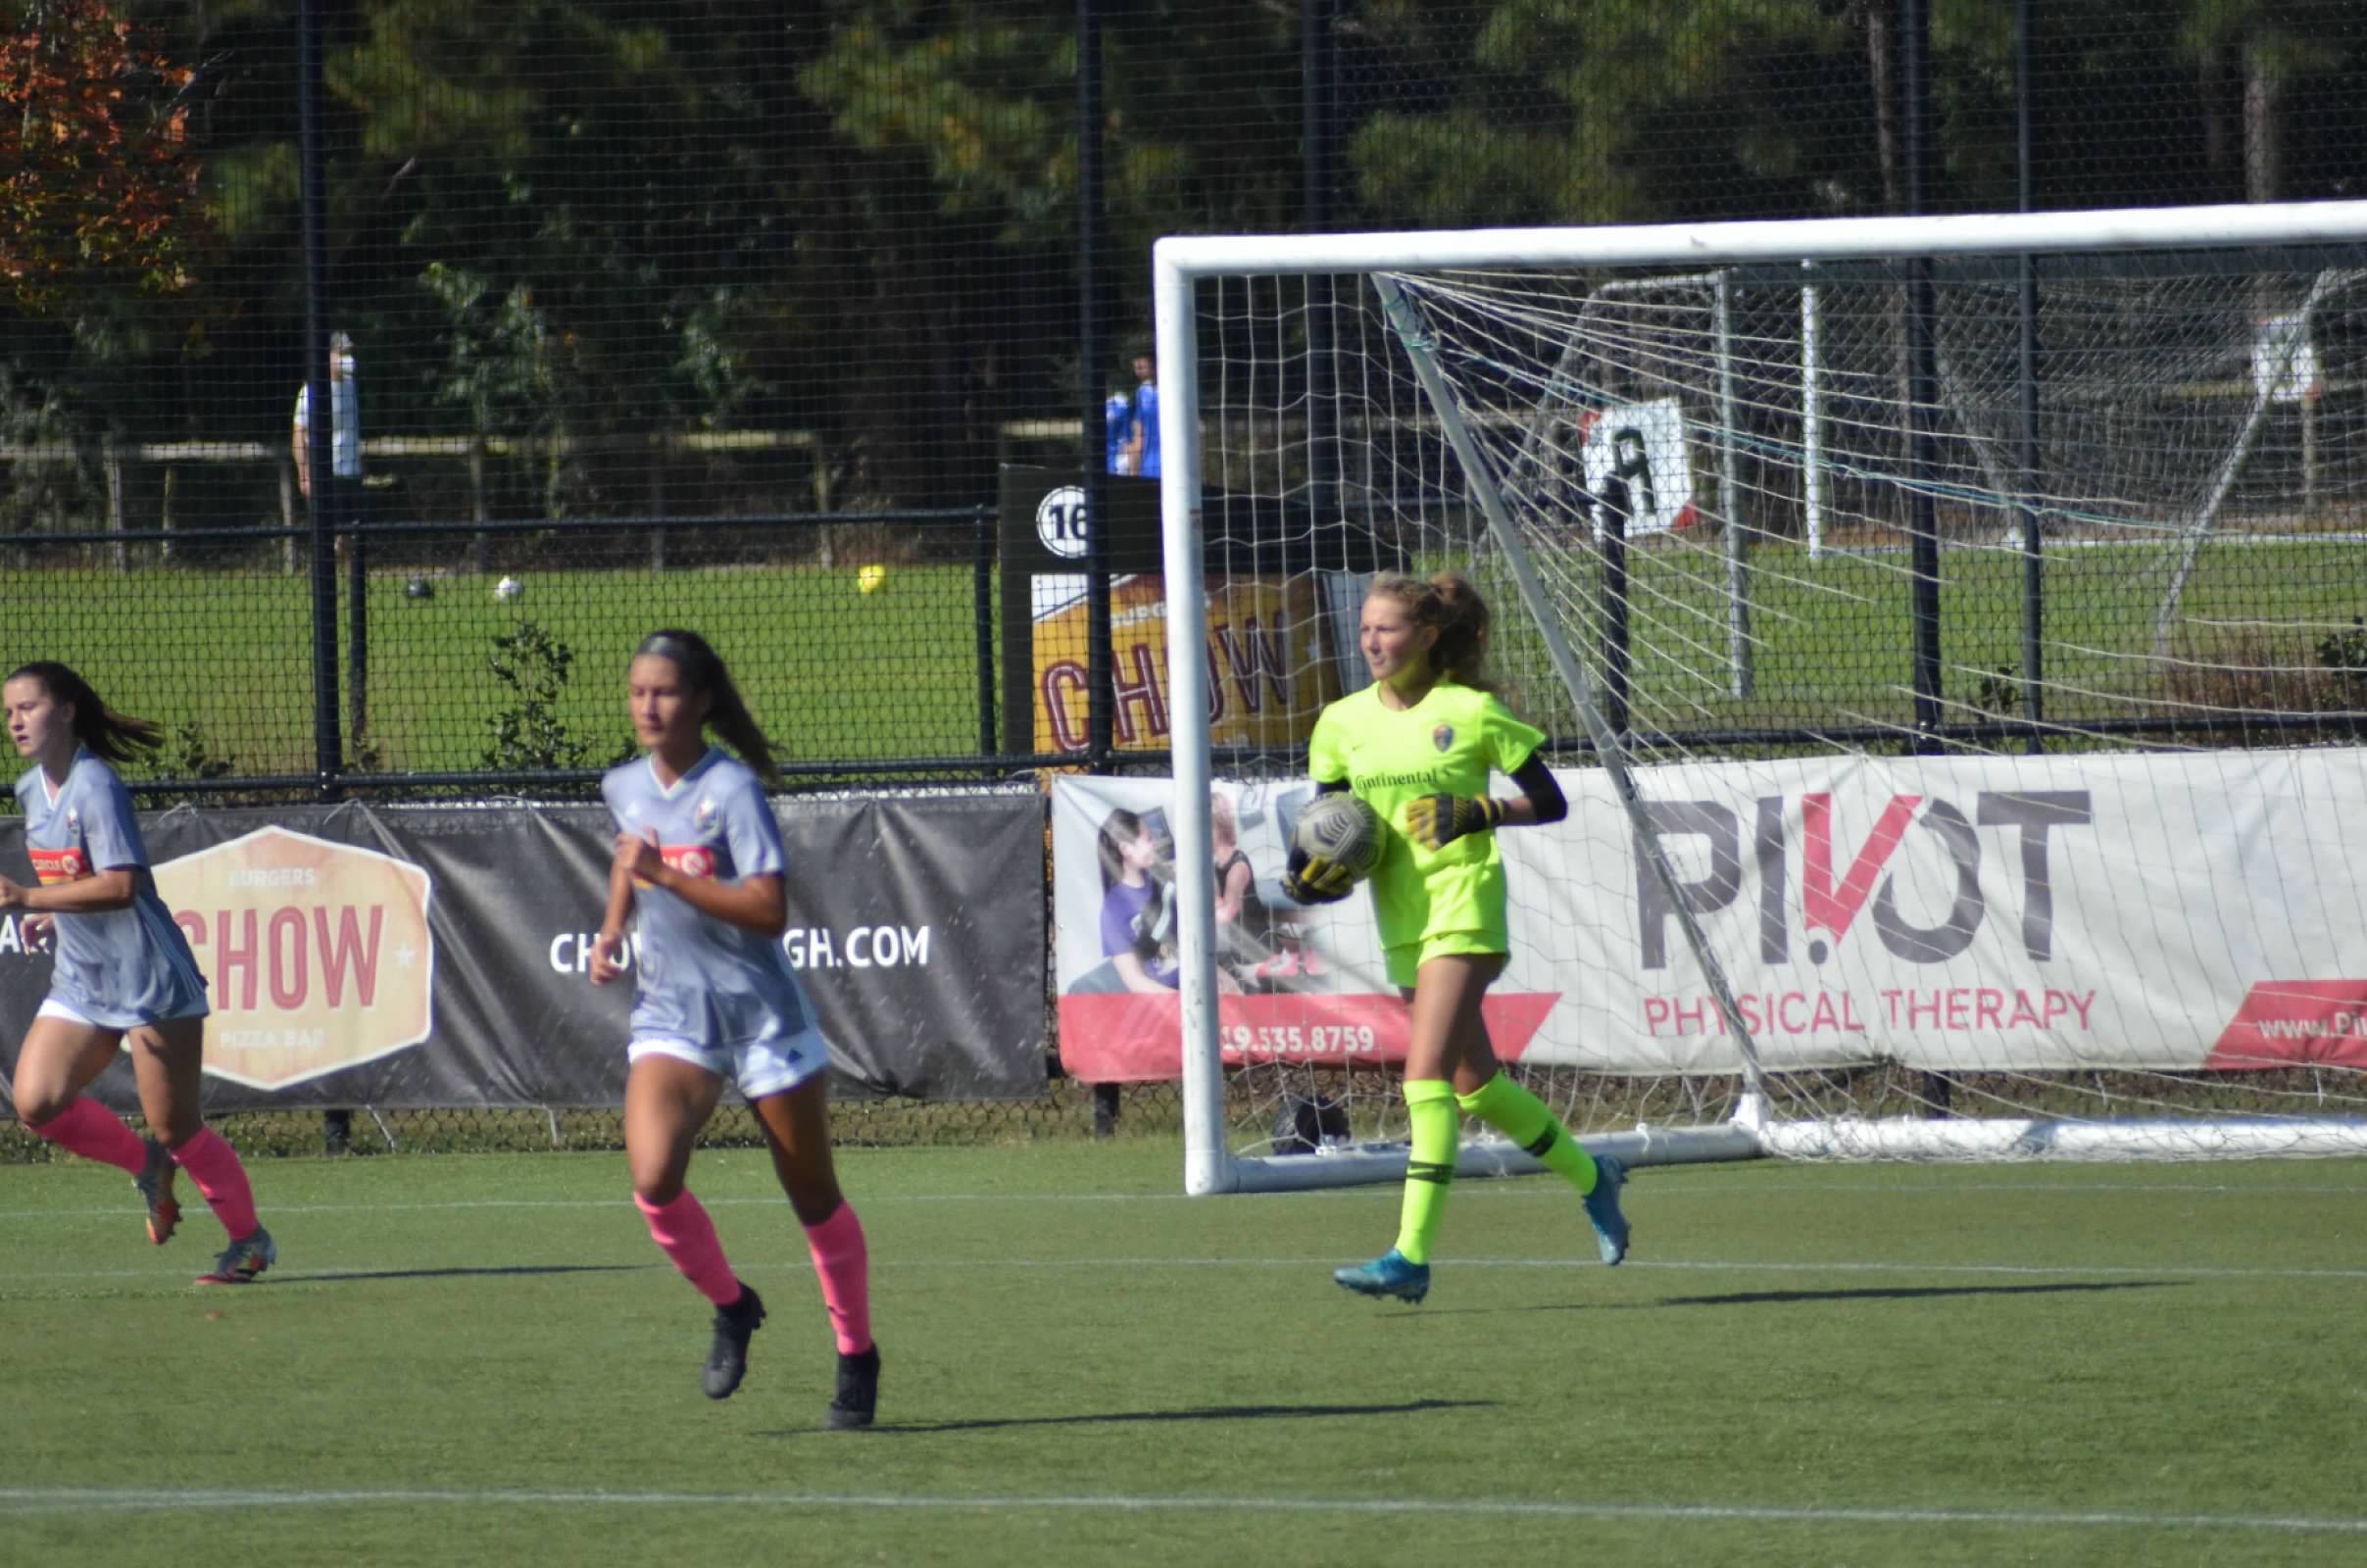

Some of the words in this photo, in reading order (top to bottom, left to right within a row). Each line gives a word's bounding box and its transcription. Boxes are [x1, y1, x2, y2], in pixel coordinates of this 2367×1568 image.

[229, 868, 315, 886] BURGERS
[1634, 790, 2091, 969] PIVOT
[1642, 992, 1866, 1037] PHYSICAL
[1881, 989, 2096, 1032] THERAPY
